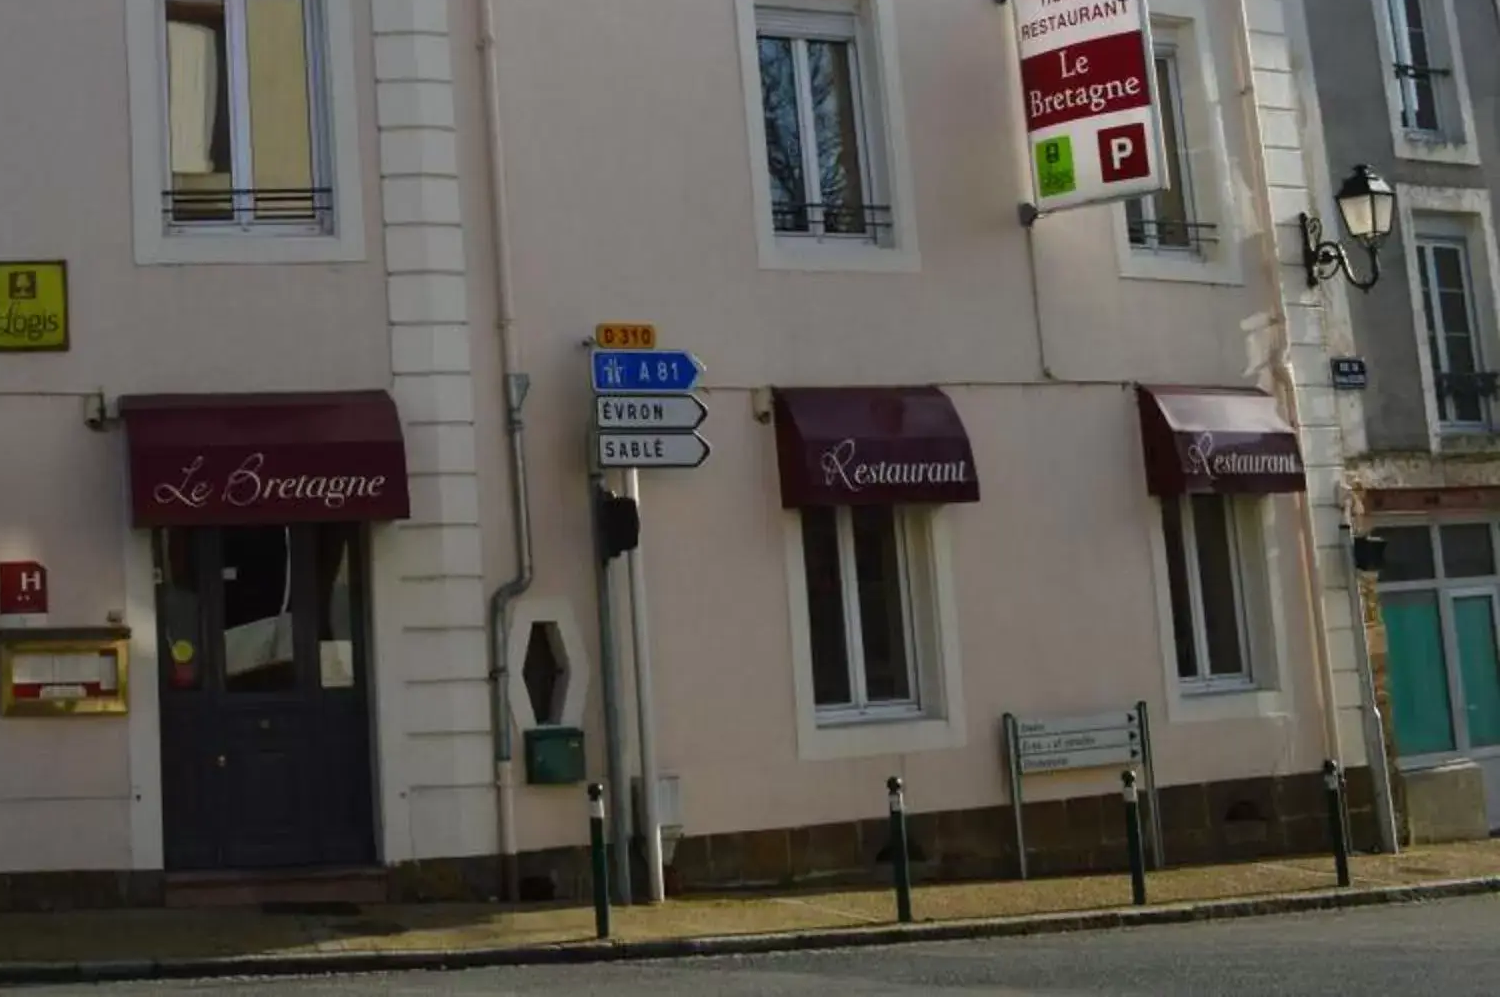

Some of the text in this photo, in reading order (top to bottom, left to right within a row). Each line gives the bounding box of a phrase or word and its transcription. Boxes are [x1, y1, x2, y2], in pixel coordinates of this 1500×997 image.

[1058, 49, 1090, 80] Le
[1030, 75, 1141, 118] Bretagne
[1110, 137, 1134, 170] P
[639, 360, 679, 382] A 81
[603, 401, 663, 421] ÉVRON
[605, 438, 664, 458] SABLÉ
[1187, 432, 1298, 481] Restaurant
[153, 453, 387, 508] Le Bretagne
[819, 438, 969, 493] Restaurant
